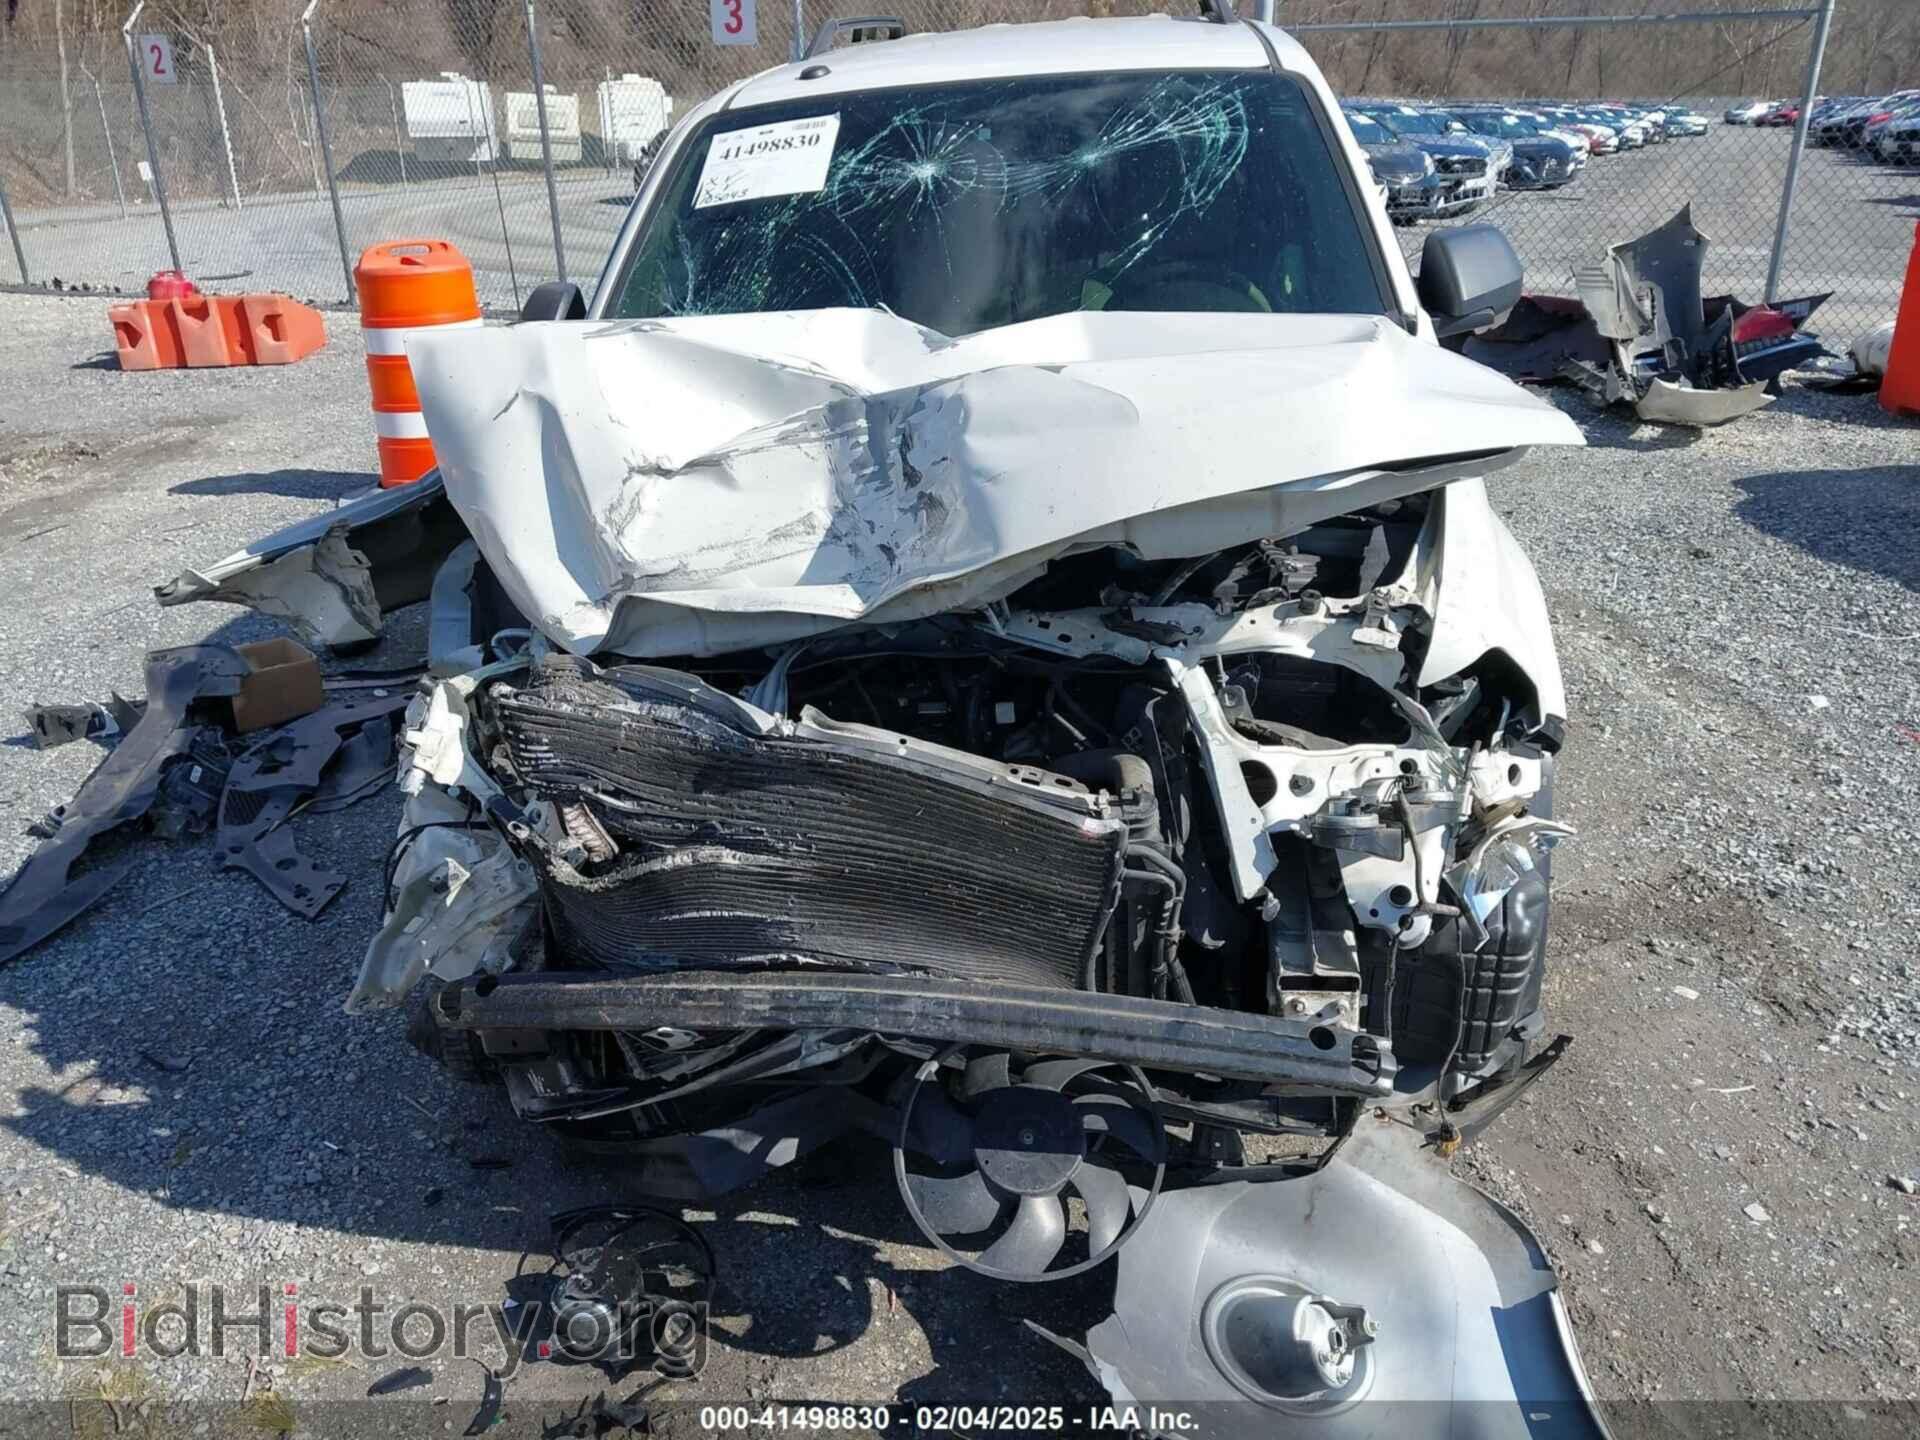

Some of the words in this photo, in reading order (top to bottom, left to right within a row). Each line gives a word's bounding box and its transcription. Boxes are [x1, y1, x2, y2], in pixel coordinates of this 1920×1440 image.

[723, 0, 743, 33] 3
[151, 44, 166, 74] 2
[721, 134, 820, 160] 41498830
